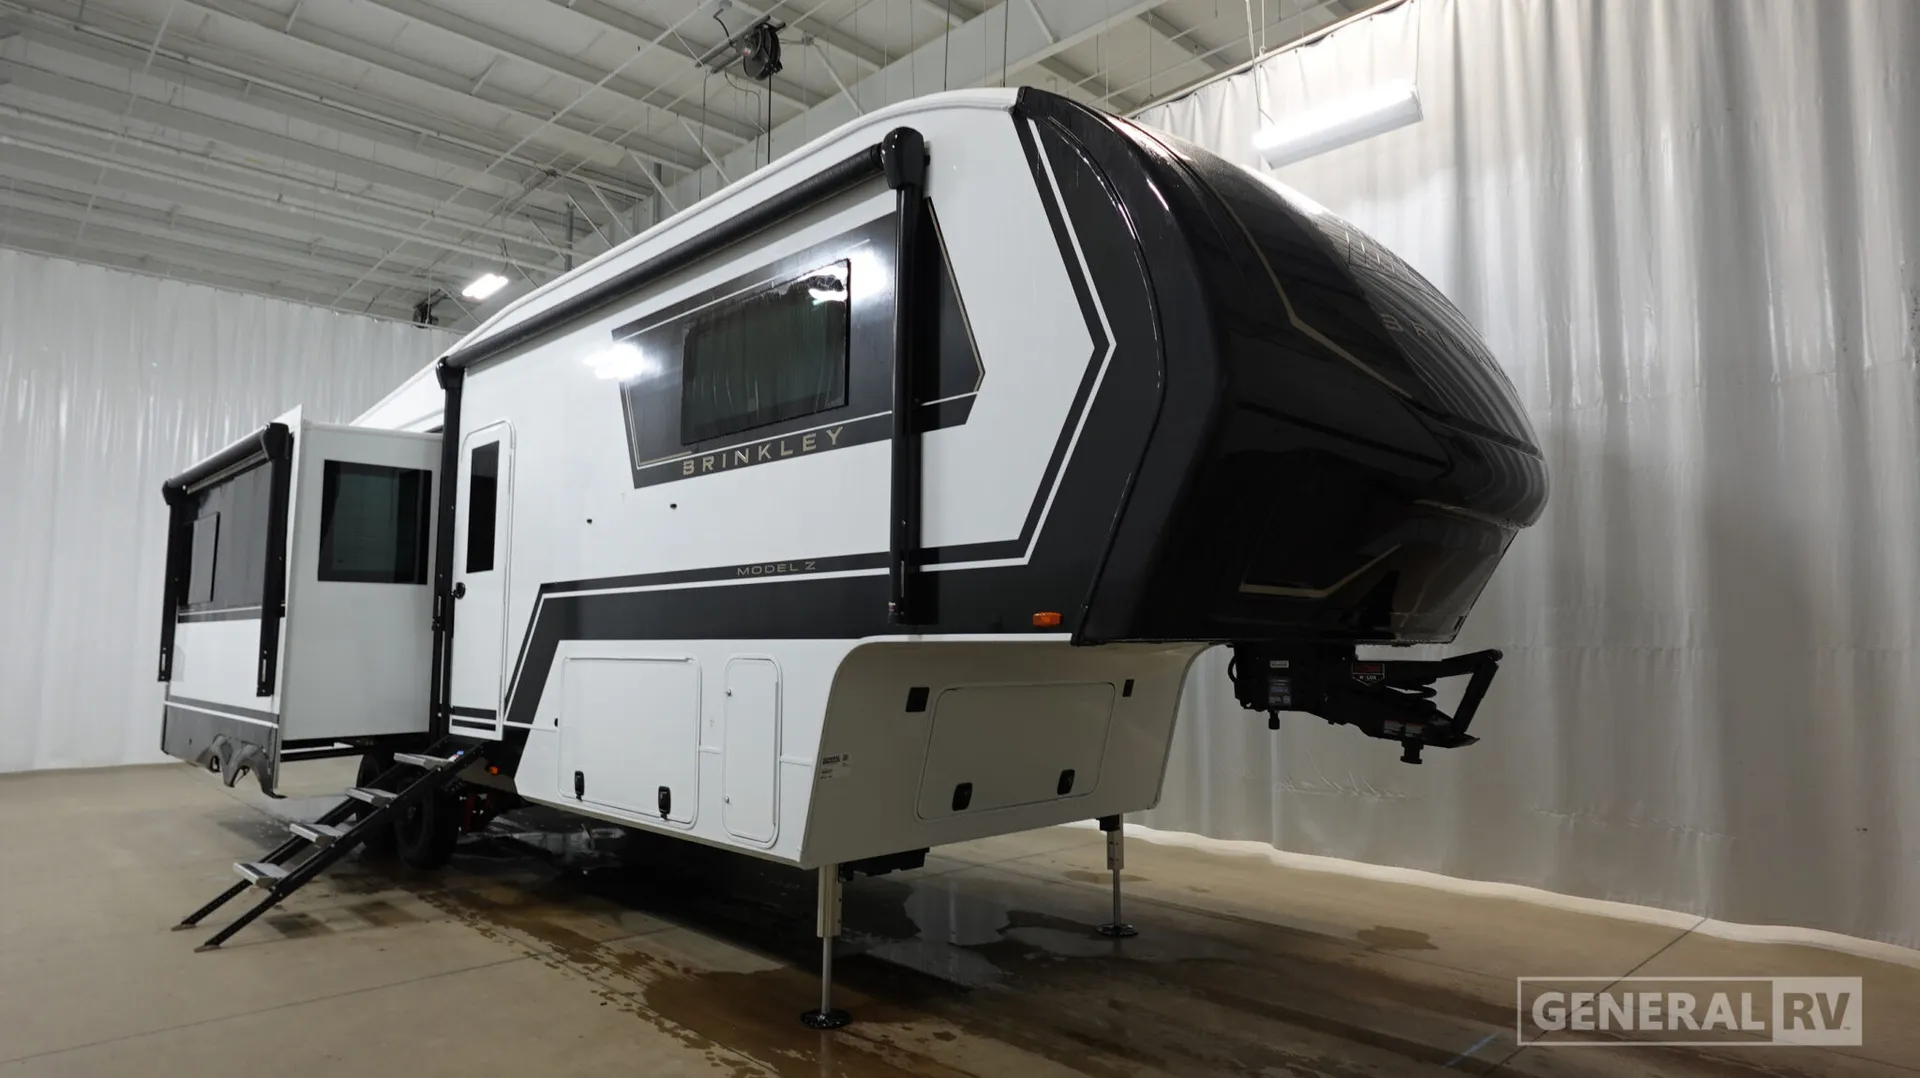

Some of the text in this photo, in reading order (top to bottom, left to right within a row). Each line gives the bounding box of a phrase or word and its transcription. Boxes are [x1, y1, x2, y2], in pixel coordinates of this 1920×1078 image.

[683, 426, 843, 476] BRINKLEY
[737, 561, 816, 576] MODEL Z
